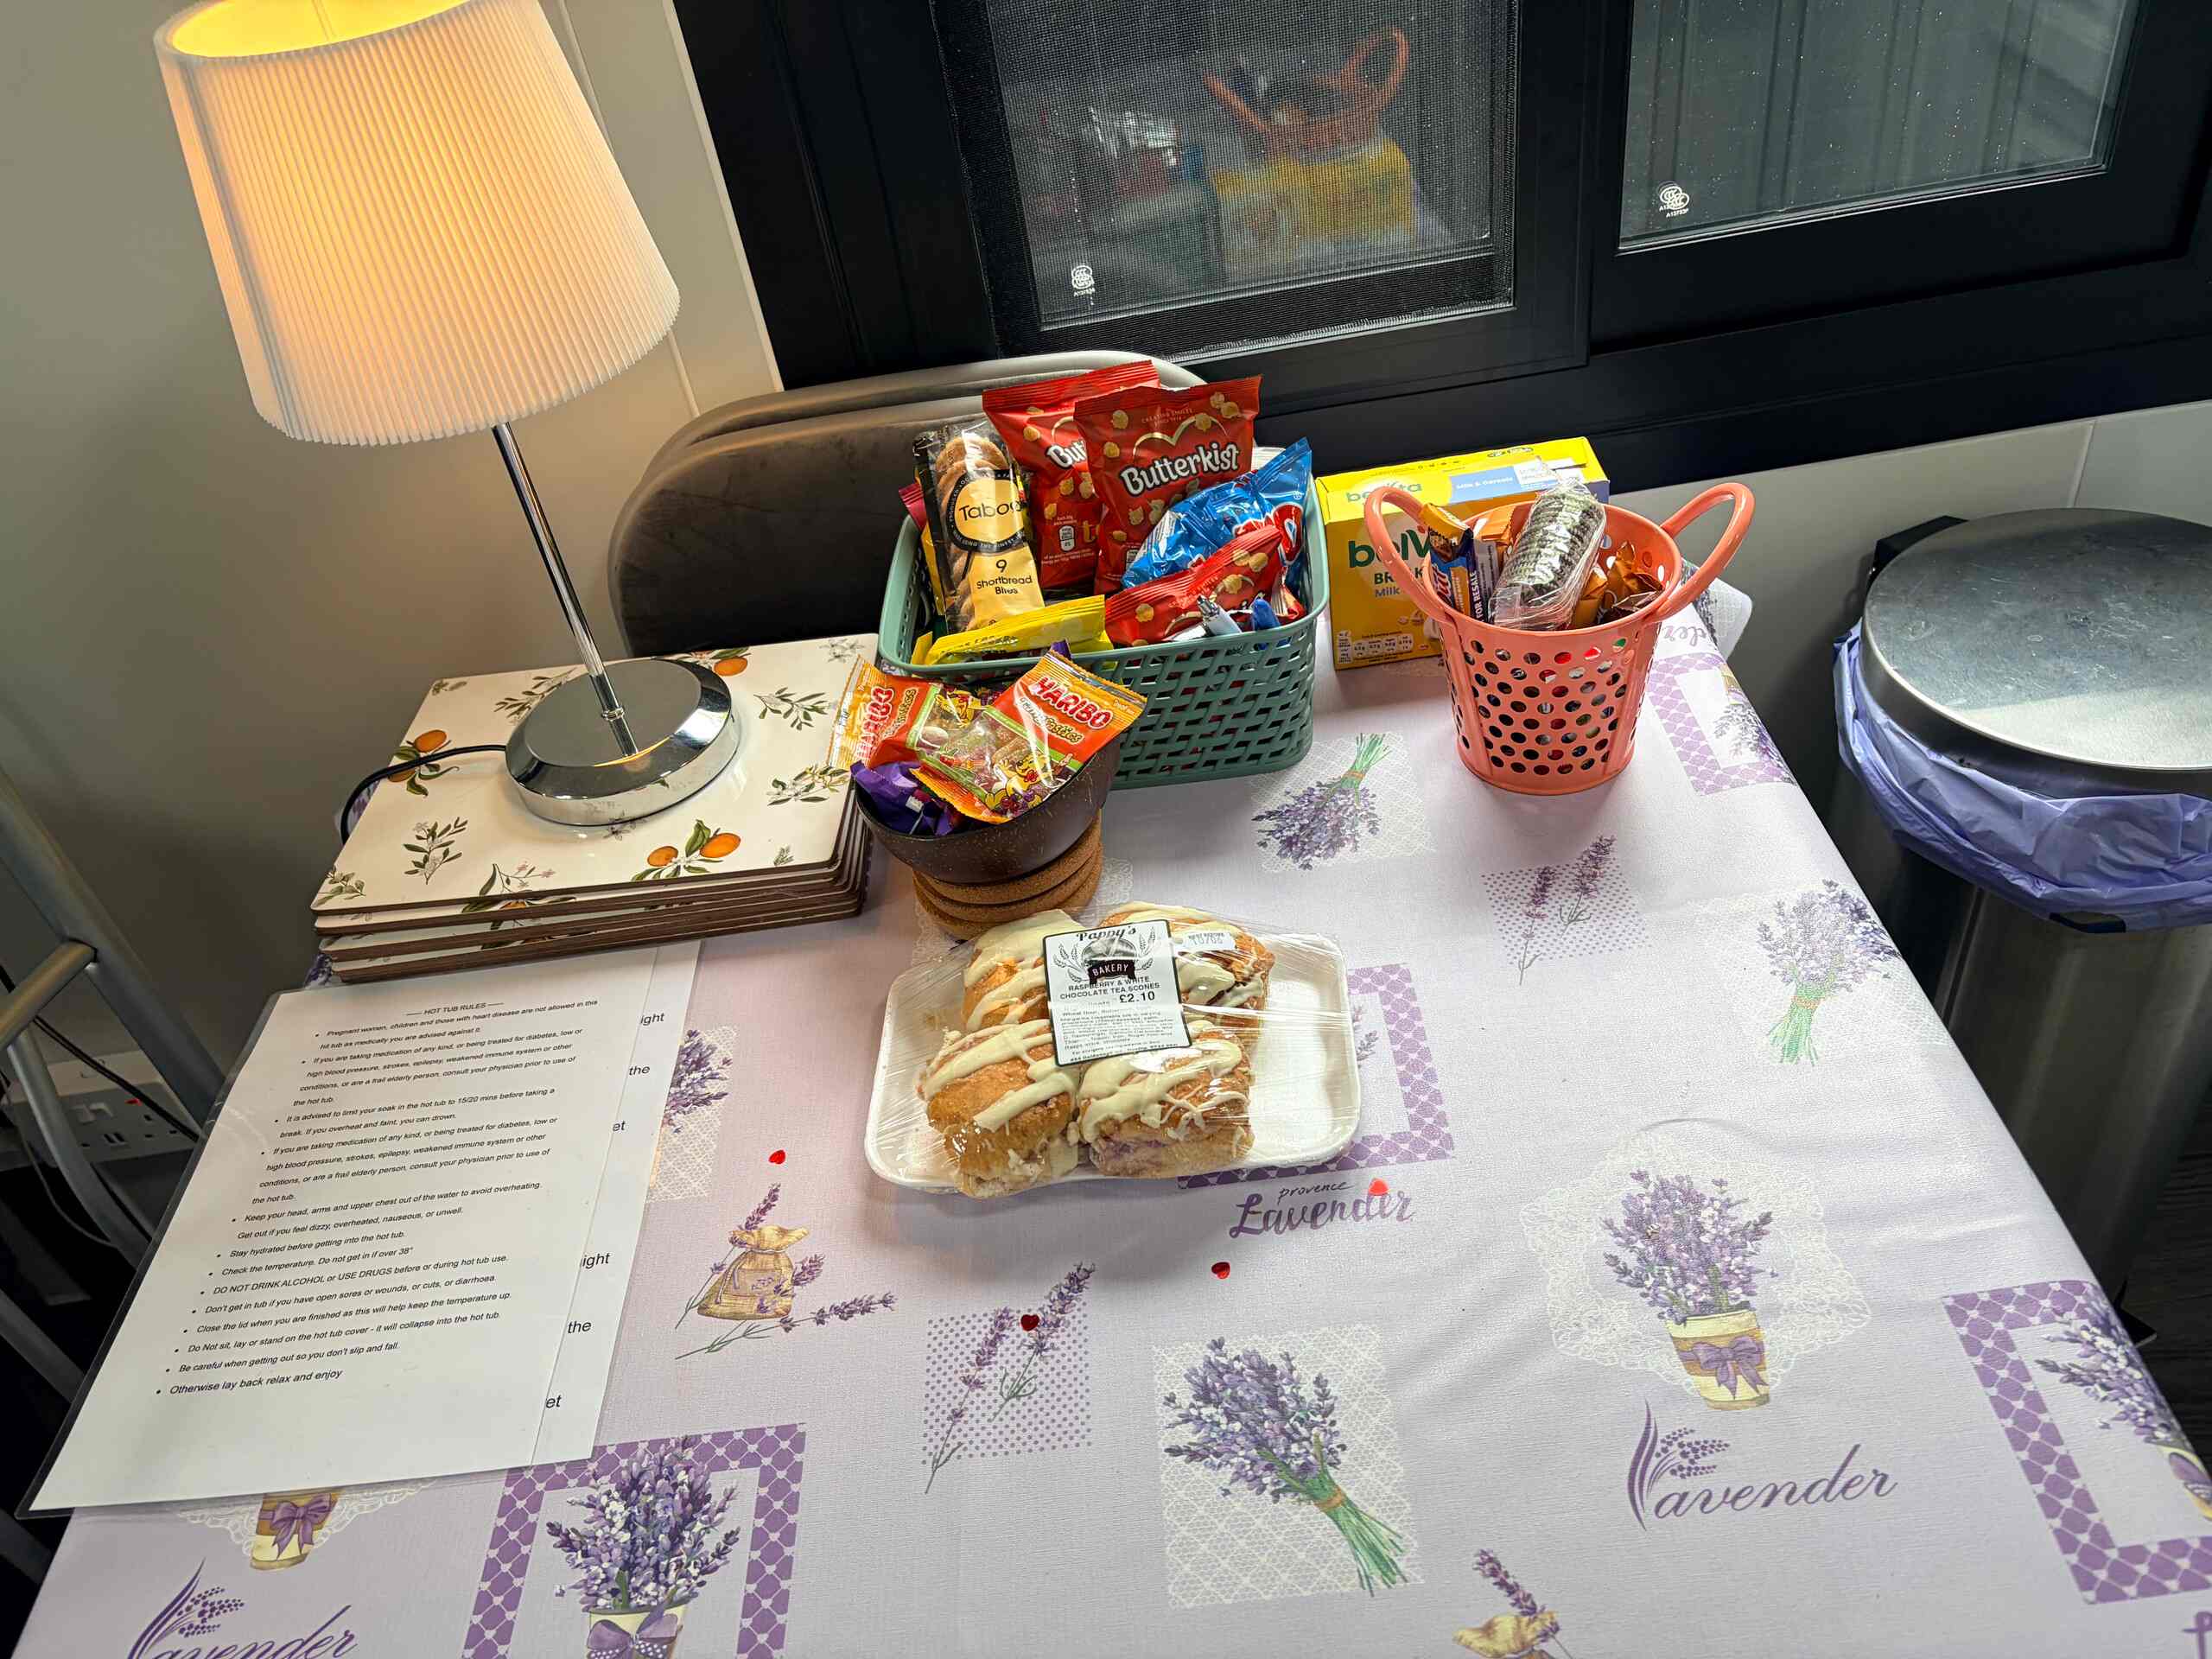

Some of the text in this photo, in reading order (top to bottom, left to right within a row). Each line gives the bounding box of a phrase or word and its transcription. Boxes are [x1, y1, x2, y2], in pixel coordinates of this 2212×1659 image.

[1121, 443, 1239, 495] Butterkist
[996, 559, 1007, 573] 9
[976, 575, 1033, 589] Shortbread
[1375, 586, 1402, 598] Milk
[1469, 571, 1484, 602] RESALE
[1029, 676, 1115, 731] HARIBO
[1092, 963, 1130, 977] BAKERY
[1059, 988, 1109, 1000] CHOCOLATE
[1128, 982, 1160, 993] SCONES
[1068, 980, 1115, 991] RASPBERRY
[1124, 976, 1150, 985] WHITE
[459, 1002, 486, 1011] RULES
[1119, 990, 1156, 1003] £2.10
[628, 1064, 651, 1077] the
[612, 1120, 626, 1133] et
[1278, 1180, 1355, 1205] provence
[237, 1230, 253, 1239] Get
[253, 1230, 268, 1238] out
[268, 1228, 276, 1236] if
[274, 1227, 291, 1237] you
[291, 1224, 308, 1234] feel
[308, 1223, 331, 1231] dizzy,
[333, 1216, 382, 1230] overheated,
[1229, 1192, 1418, 1240] Lavender
[229, 1249, 249, 1258] Stay
[249, 1244, 287, 1257] hydrated
[286, 1243, 314, 1251] before
[314, 1238, 343, 1249] getting
[375, 1232, 390, 1241] hot
[221, 1266, 249, 1276] Check
[317, 1256, 331, 1265] Do
[331, 1255, 346, 1264] not
[346, 1253, 361, 1263] get
[580, 1253, 611, 1269] ight
[212, 1286, 228, 1295] DO
[228, 1283, 251, 1293] NOT
[250, 1280, 282, 1291] DRINK
[280, 1274, 326, 1287] ALCOHOL
[337, 1271, 358, 1281] USE
[358, 1267, 393, 1278] DRUGS
[393, 1264, 421, 1274] before
[430, 1260, 460, 1271] during
[460, 1257, 475, 1266] hot
[475, 1255, 490, 1264] tub
[204, 1304, 228, 1313] Don't
[227, 1303, 244, 1313] get
[243, 1301, 252, 1310] in
[253, 1300, 268, 1309] tub
[268, 1299, 276, 1307] if
[274, 1299, 292, 1308] you
[293, 1295, 315, 1304] have
[315, 1293, 337, 1303] open
[336, 1290, 362, 1300] sores
[372, 1284, 409, 1296] wounds,
[196, 1325, 222, 1333] Close
[222, 1322, 237, 1331] the
[237, 1320, 250, 1329] lid
[250, 1319, 273, 1328] when
[272, 1317, 291, 1327] you
[291, 1315, 307, 1324] are
[308, 1309, 342, 1321] finished
[354, 1306, 371, 1316] this
[372, 1305, 387, 1313] will
[386, 1302, 406, 1313] help
[407, 1301, 429, 1310] keep
[429, 1299, 445, 1307] the
[446, 1294, 498, 1306] temperature
[187, 1344, 200, 1353] Do
[201, 1342, 219, 1351] Not
[232, 1340, 247, 1350] lay
[258, 1335, 284, 1345] stand
[313, 1331, 328, 1339] hot
[328, 1329, 343, 1338] tub
[344, 1326, 370, 1336] cover
[383, 1321, 398, 1332] will
[398, 1319, 435, 1330] collapse
[454, 1314, 468, 1324] the
[469, 1313, 484, 1321] hot
[567, 1319, 593, 1334] the
[178, 1363, 192, 1373] Be
[192, 1361, 224, 1371] careful
[224, 1359, 248, 1369] when
[247, 1355, 278, 1368] getting
[279, 1353, 295, 1363] out
[306, 1351, 325, 1361] you
[326, 1347, 348, 1357] don't
[348, 1346, 365, 1356] slip
[365, 1343, 384, 1353] and
[169, 1369, 343, 1395] Otherwise lay back relax and enjoy
